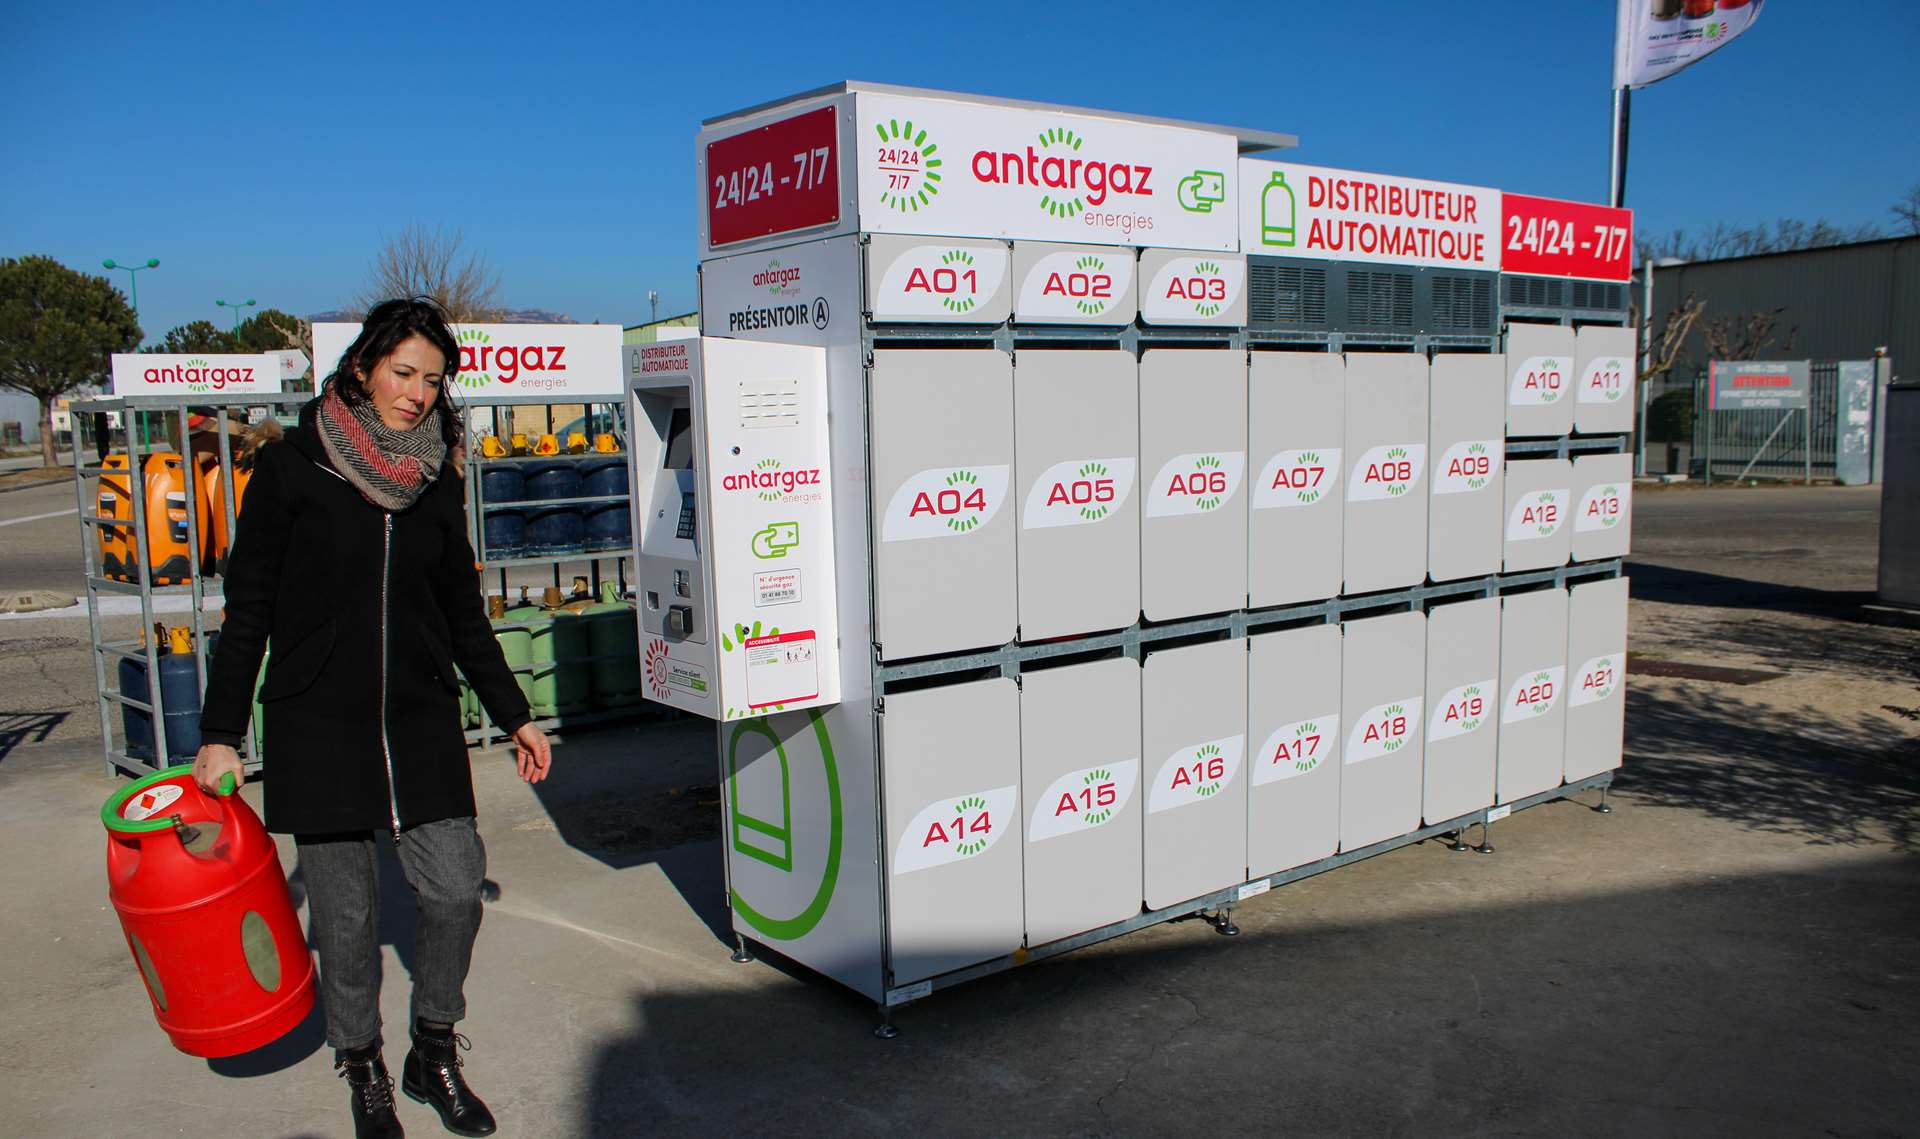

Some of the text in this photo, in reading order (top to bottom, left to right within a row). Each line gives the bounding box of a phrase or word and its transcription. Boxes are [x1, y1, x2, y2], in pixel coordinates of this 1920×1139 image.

[878, 149, 919, 165] 24/24
[715, 162, 774, 209] 24/24
[793, 147, 829, 190] 7/7
[889, 174, 910, 190] 7/7
[972, 146, 1153, 206] antargaz
[1308, 176, 1477, 224] DISTRIBUTEUR
[1084, 211, 1154, 235] energies
[1306, 218, 1484, 263] AUTOMATIQUE
[1507, 214, 1575, 255] 24/24
[1594, 225, 1627, 262] 7/7
[752, 267, 800, 287] antargaz
[904, 267, 977, 295] A01
[1043, 272, 1112, 298] A02
[1167, 277, 1226, 302] A03
[729, 303, 809, 332] PRÉSENTOIR
[458, 345, 566, 384] argaz
[641, 345, 686, 359] DISTRIBUTEUR
[144, 364, 255, 390] antargaz
[641, 359, 689, 373] AUTOMATIQUE
[520, 378, 567, 390] energies
[1524, 370, 1560, 390] A10
[1590, 370, 1621, 389] A11
[1271, 465, 1325, 490] A07
[1364, 461, 1412, 483] A08
[1448, 456, 1489, 477] A09
[722, 469, 821, 493] antargaz
[1046, 479, 1116, 507] A05
[1167, 472, 1226, 497] A06
[782, 493, 822, 504] energies
[909, 488, 987, 518] A04
[1587, 497, 1619, 517] A13
[1521, 504, 1557, 526] A12
[1581, 668, 1613, 692] A21
[1515, 681, 1553, 706] A20
[1444, 697, 1483, 722] A19
[1363, 715, 1407, 743] A18
[1272, 735, 1321, 763] A17
[1170, 757, 1225, 790] A16
[1055, 783, 1117, 817] A15
[923, 811, 992, 848] A14
